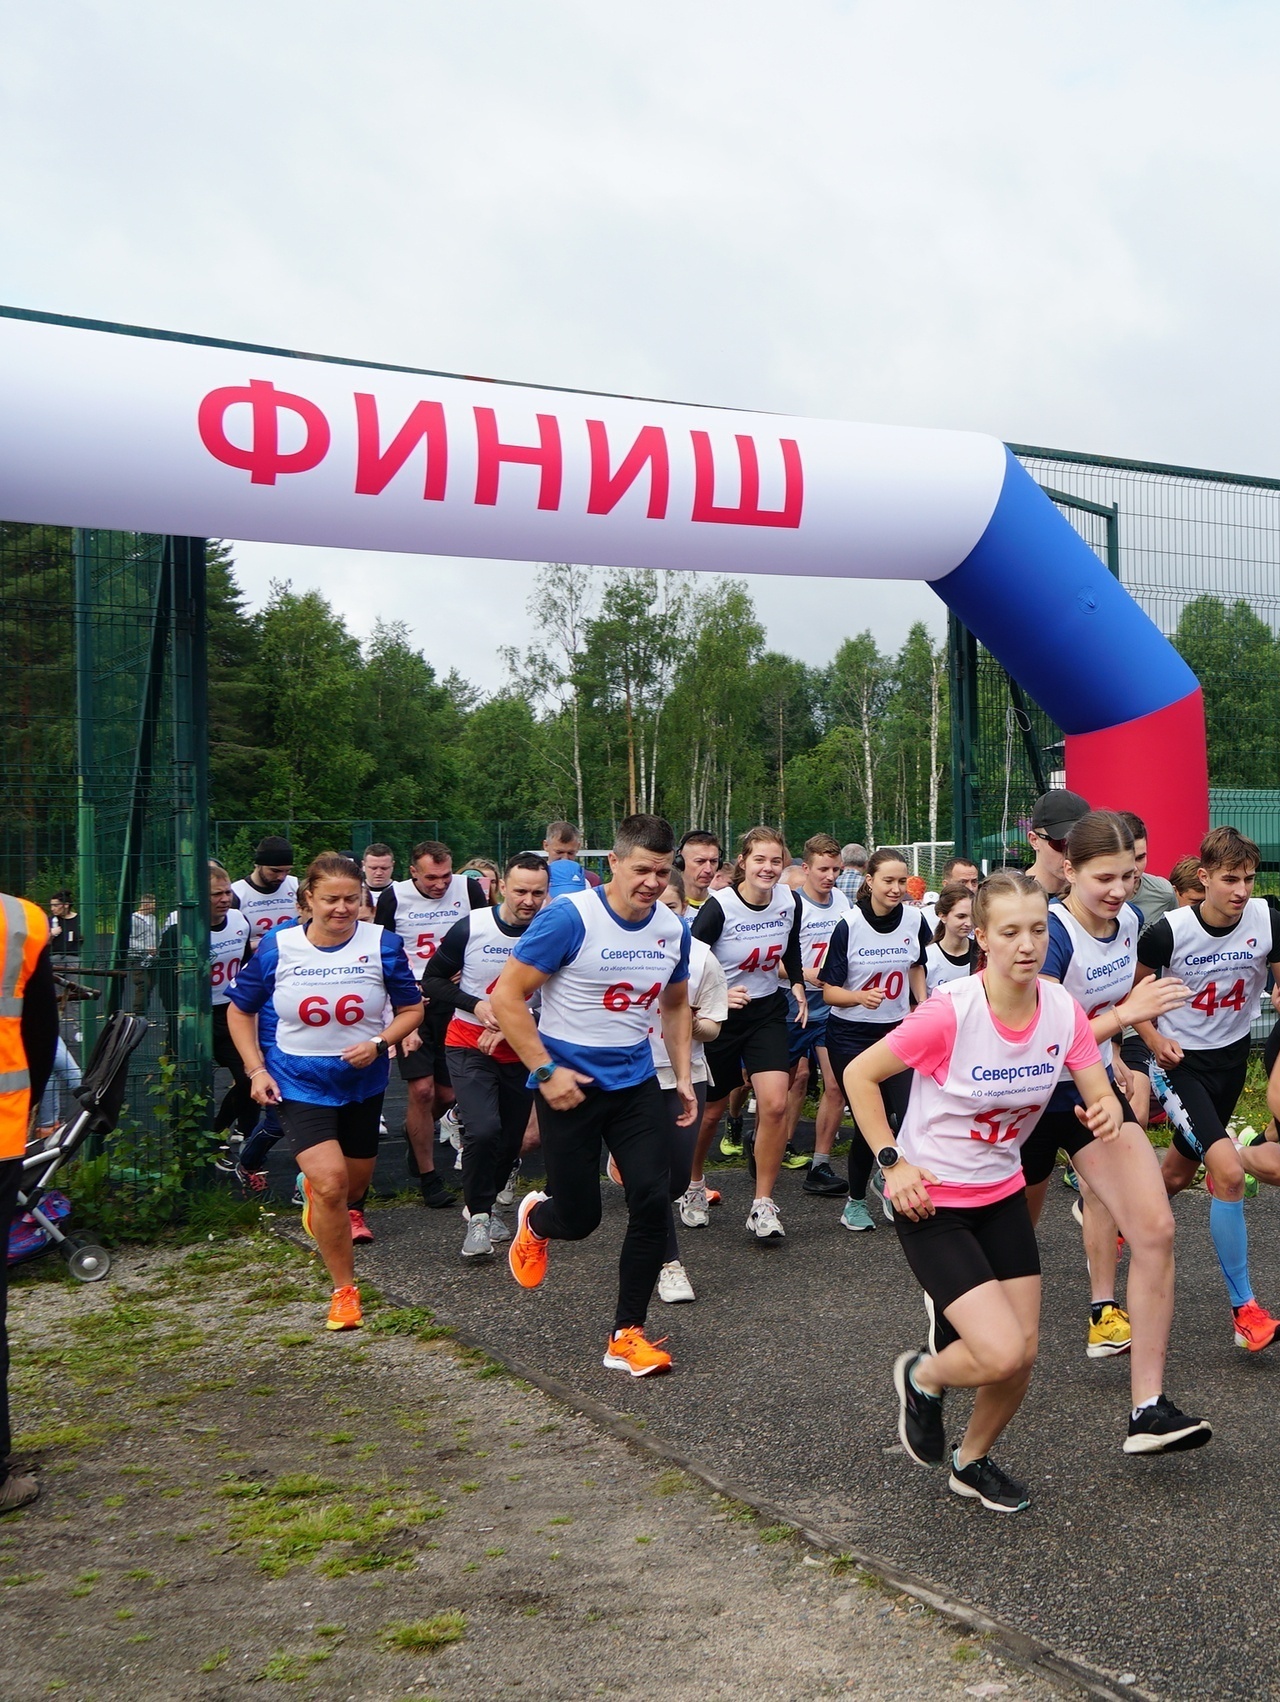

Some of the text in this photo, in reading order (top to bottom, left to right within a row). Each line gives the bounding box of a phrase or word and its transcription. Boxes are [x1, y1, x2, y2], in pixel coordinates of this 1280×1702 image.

[198, 379, 803, 528] ФИНИШ
[408, 910, 459, 920] Северсталь
[735, 920, 784, 932] Северсталь
[601, 948, 665, 961] Северсталь
[739, 945, 782, 973] 45
[859, 947, 908, 957] Северсталь
[1185, 951, 1253, 966] Северсталь
[294, 966, 364, 977] Северсталь
[1086, 955, 1131, 981] Северсталь
[603, 982, 661, 1012] 64
[861, 971, 903, 1000] 40
[1191, 979, 1246, 1017] 44
[298, 994, 364, 1027] 66
[971, 1062, 1055, 1083] Северсталь
[984, 1085, 1026, 1098] «Карельский
[970, 1104, 1041, 1145] 52
